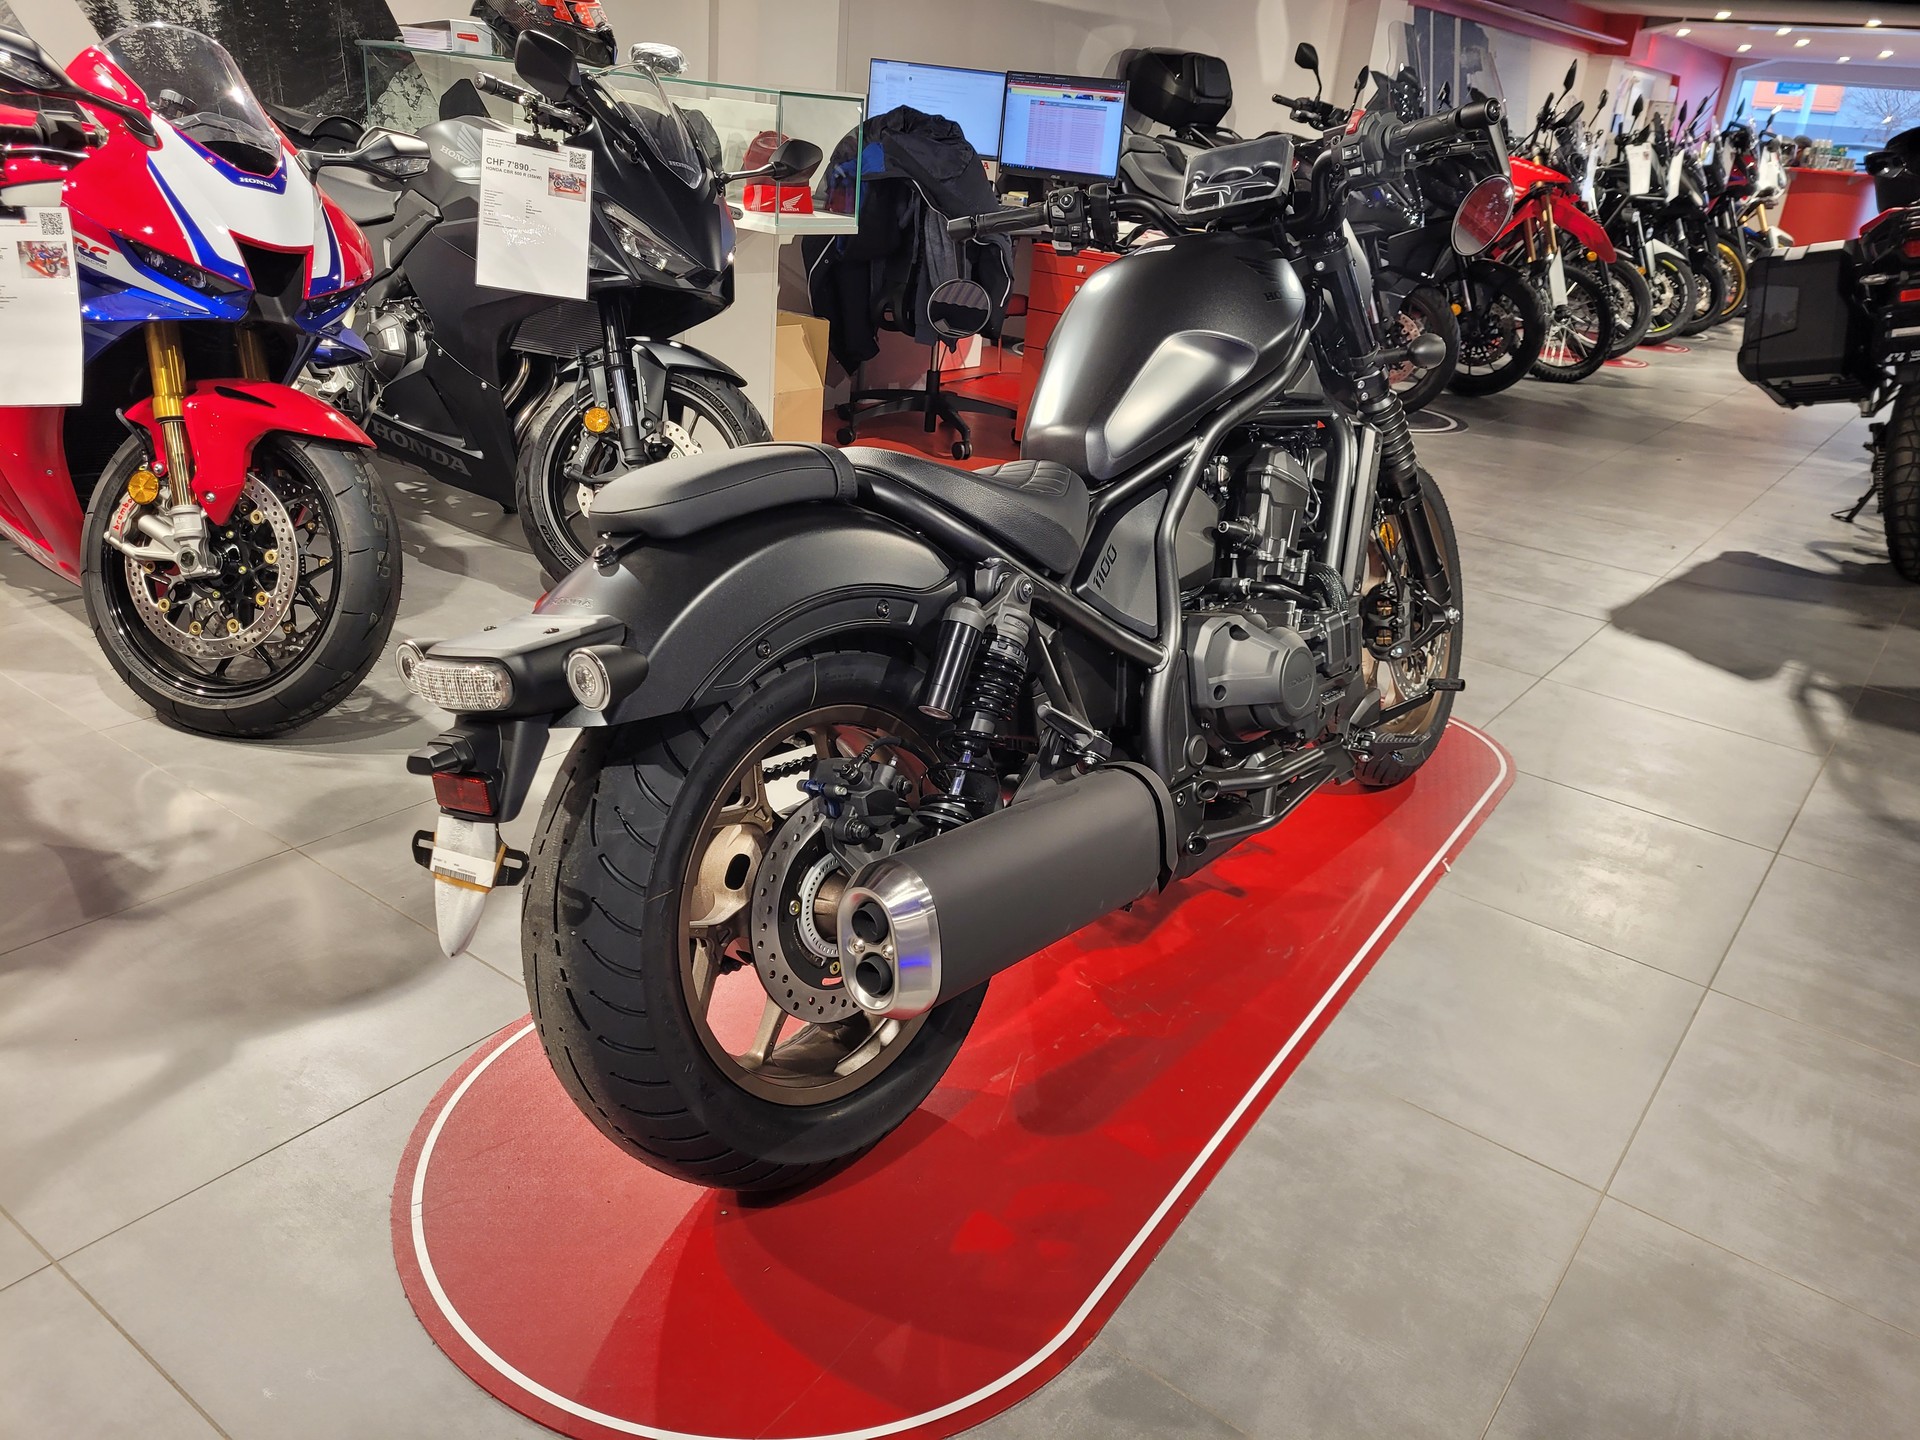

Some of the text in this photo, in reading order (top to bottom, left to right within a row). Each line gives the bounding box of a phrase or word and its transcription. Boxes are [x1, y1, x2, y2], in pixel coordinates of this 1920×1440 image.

[440, 144, 476, 168] HONDA
[486, 156, 504, 166] CHF
[668, 160, 696, 174] HONDA
[239, 176, 278, 190] HONDA
[372, 419, 472, 477] HONDA
[113, 498, 132, 530] brembo
[1093, 543, 1117, 590] 1100
